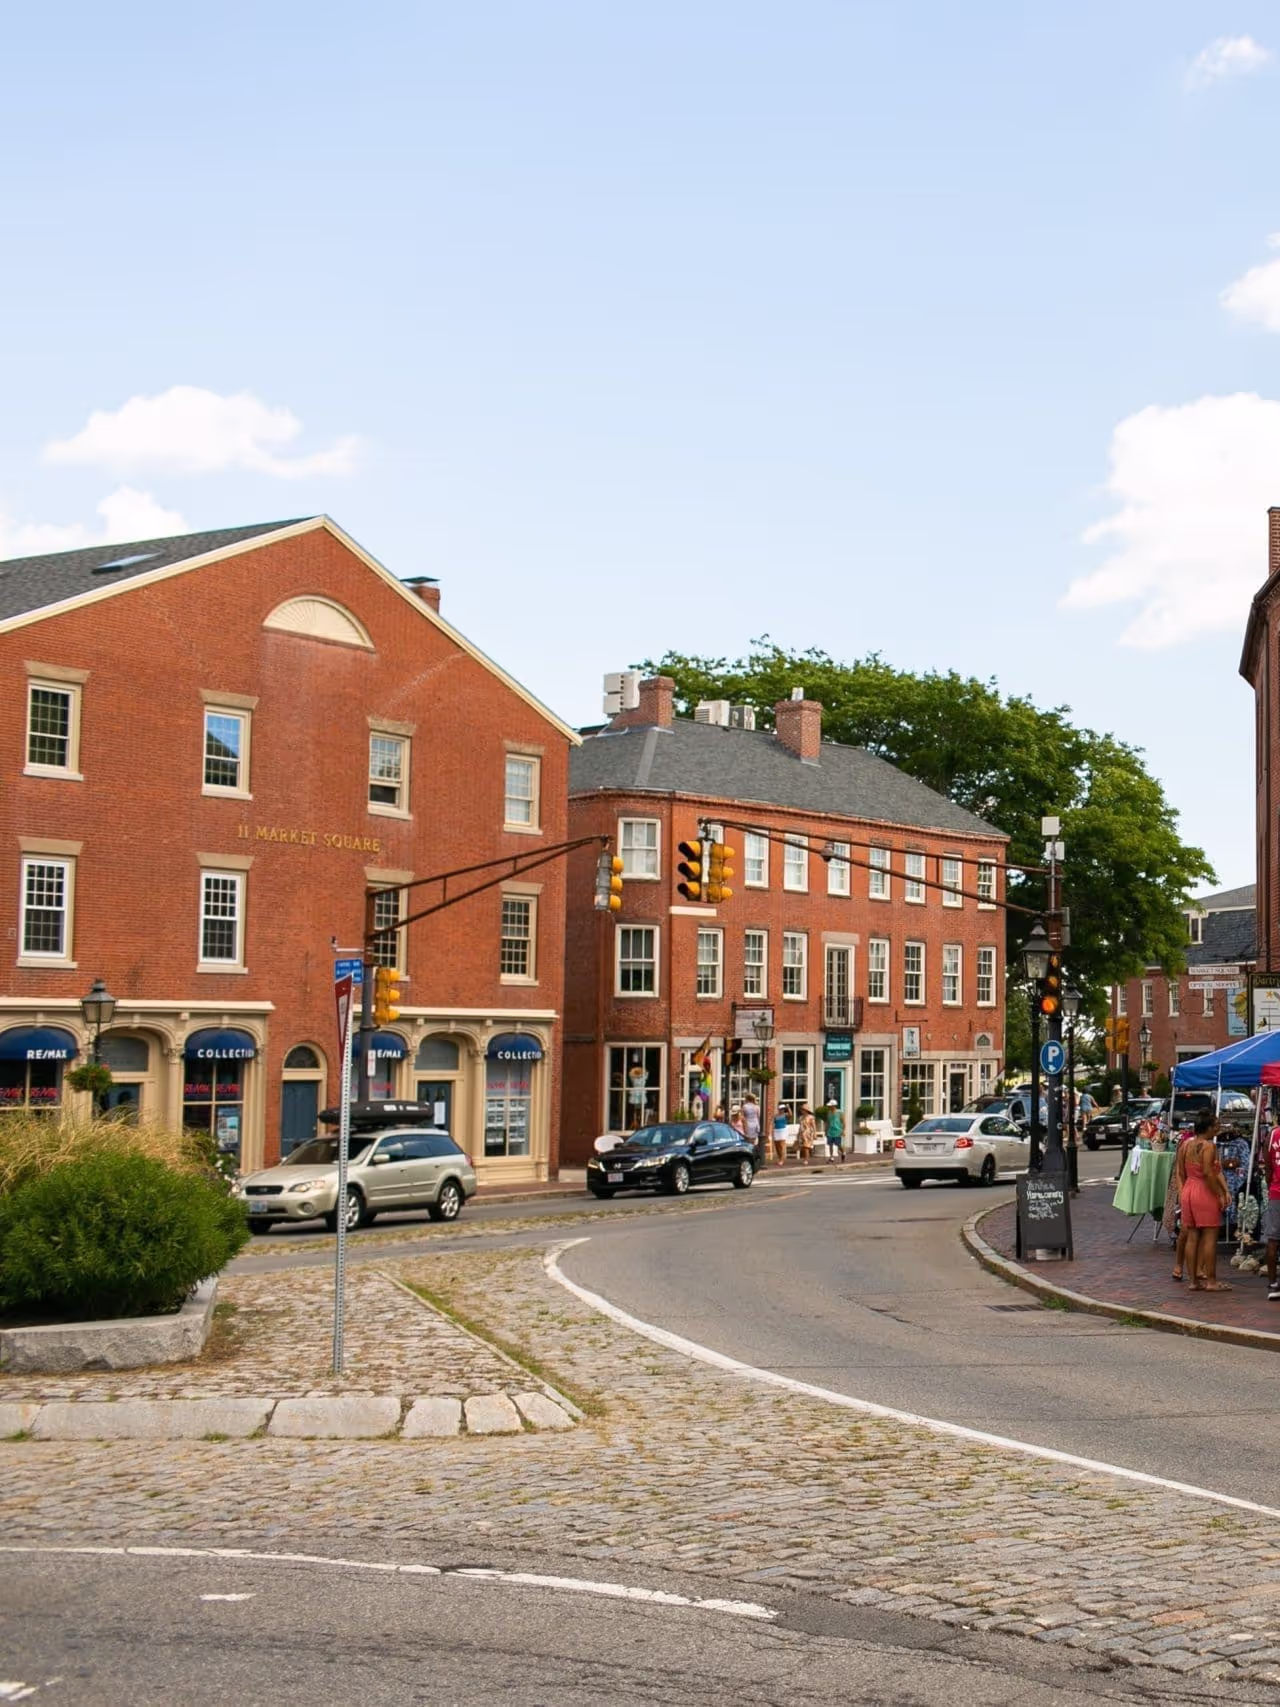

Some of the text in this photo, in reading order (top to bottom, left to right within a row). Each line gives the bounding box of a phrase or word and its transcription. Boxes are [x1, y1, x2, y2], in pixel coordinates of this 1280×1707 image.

[255, 825, 318, 846] MARKET
[323, 833, 381, 853] SQUARE
[26, 1049, 67, 1060] RE/MAX
[376, 1048, 403, 1058] E/MAX
[1047, 1046, 1060, 1063] P
